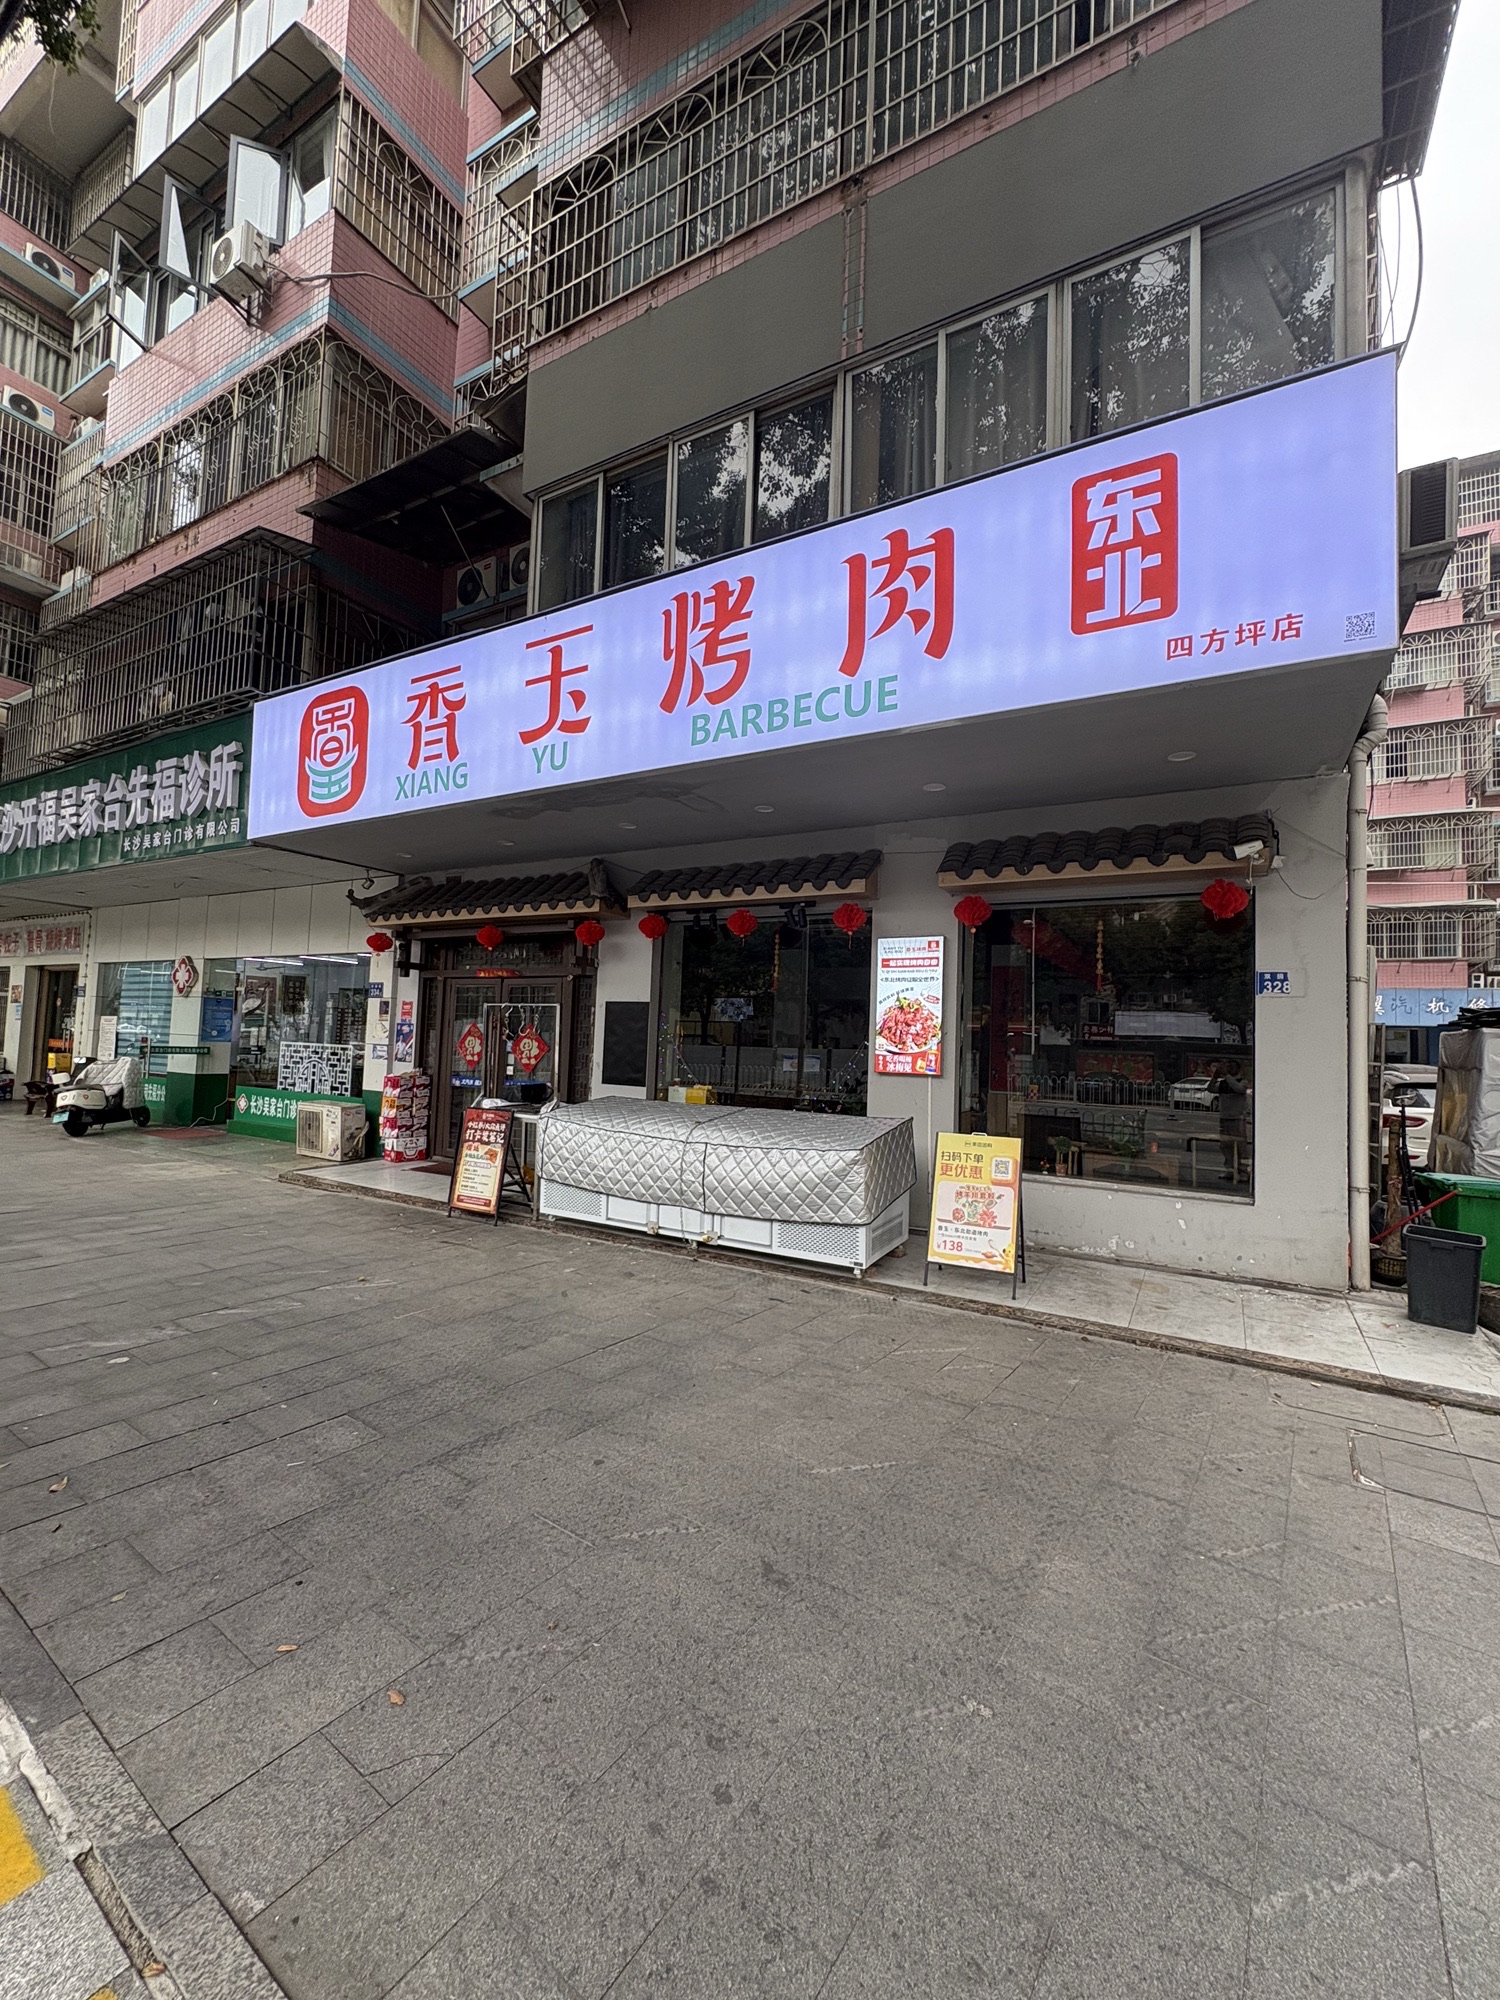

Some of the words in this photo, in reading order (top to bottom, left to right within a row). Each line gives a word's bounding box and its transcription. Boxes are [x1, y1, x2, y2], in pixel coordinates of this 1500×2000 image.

[1086, 468, 1162, 624] 东北
[405, 528, 954, 770] 香玉烤肉
[1167, 613, 1303, 661] 四方坪店
[395, 762, 469, 801] XIANG
[532, 742, 569, 775] YU
[692, 676, 898, 746] BARBECUE
[0, 741, 243, 856] 沙开福吴家台先福诊所
[123, 817, 241, 852] 长沙吴家台门诊有限公司
[1264, 981, 1291, 993] 328
[250, 1094, 299, 1120] 长沙吴家台门诊
[940, 1162, 984, 1180] 更优惠
[941, 1150, 984, 1164] 扫码下单
